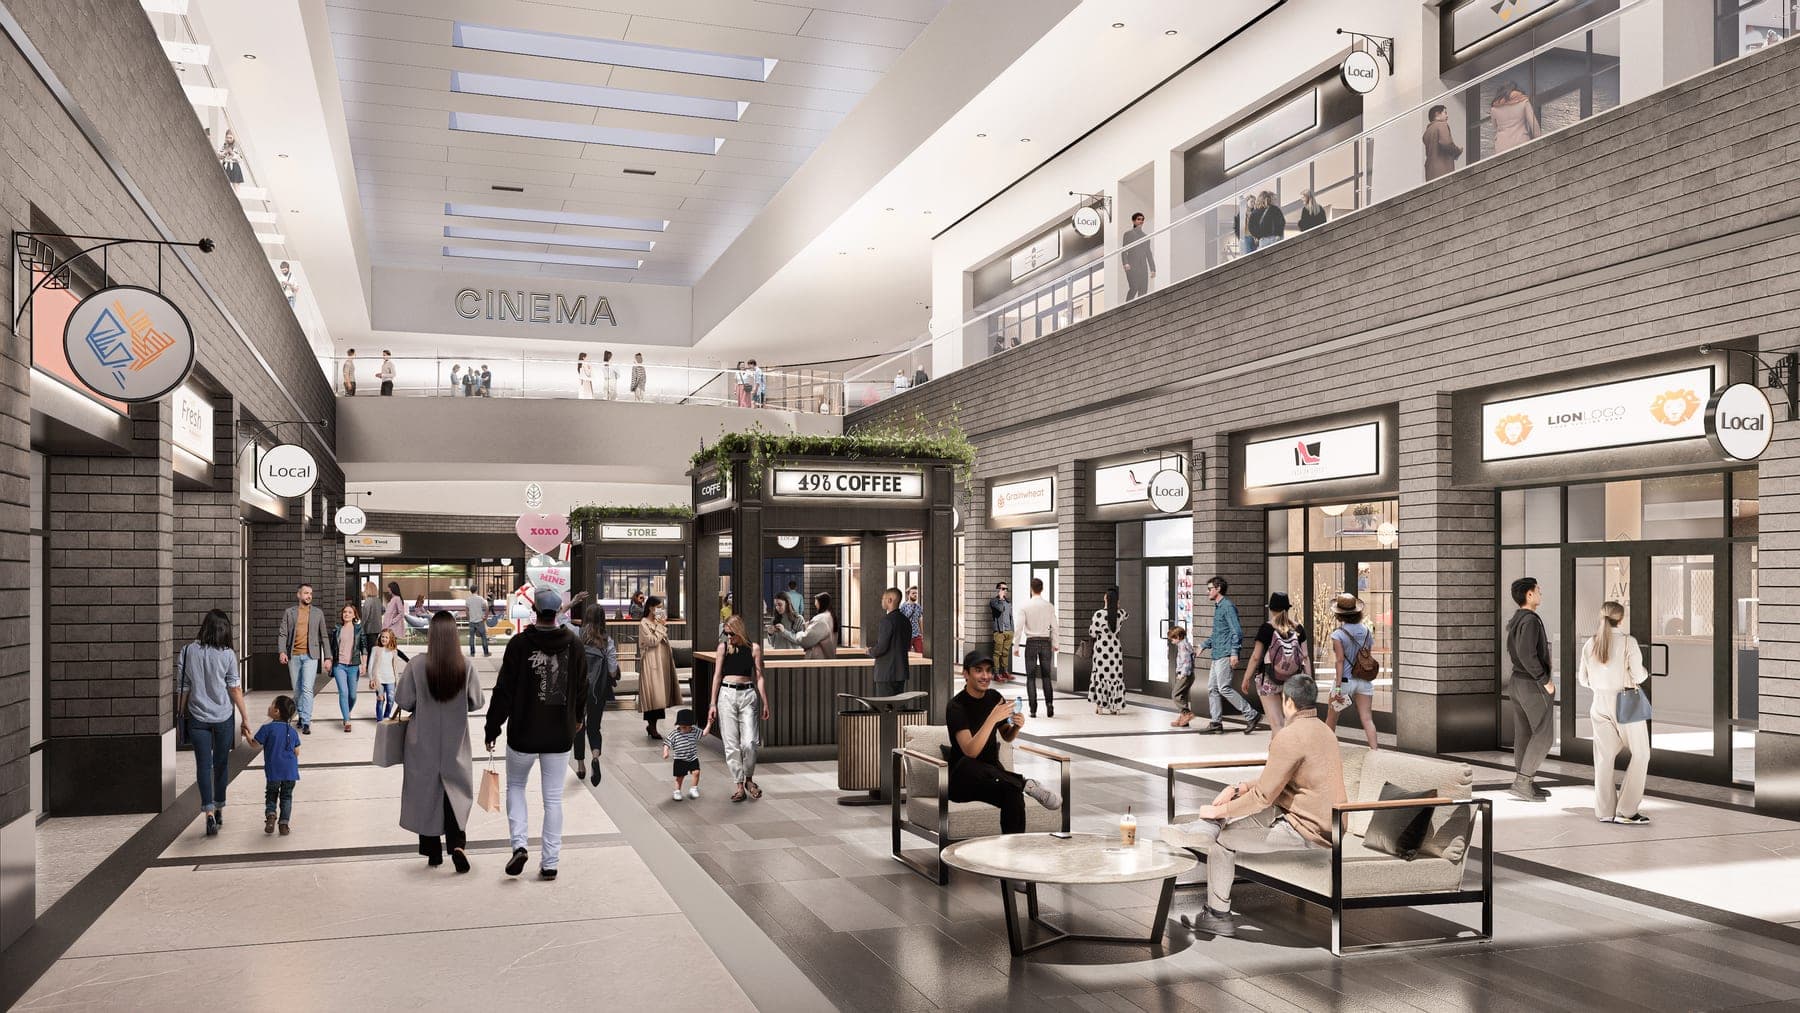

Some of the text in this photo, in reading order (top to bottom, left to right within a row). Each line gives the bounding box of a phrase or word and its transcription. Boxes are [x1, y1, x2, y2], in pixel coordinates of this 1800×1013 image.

[1348, 65, 1374, 78] Local
[1077, 217, 1097, 226] Local
[454, 288, 617, 327] CINEMA
[181, 399, 202, 431] Fresh
[1721, 411, 1764, 431] Local
[269, 464, 311, 478] Local
[836, 475, 902, 493] COFFEE
[1005, 488, 1044, 501] Grainwheat
[1155, 485, 1184, 497] Local
[339, 516, 363, 525] Local
[530, 528, 559, 536] XOXO
[627, 528, 658, 537] STORE
[540, 573, 567, 586] MINE
